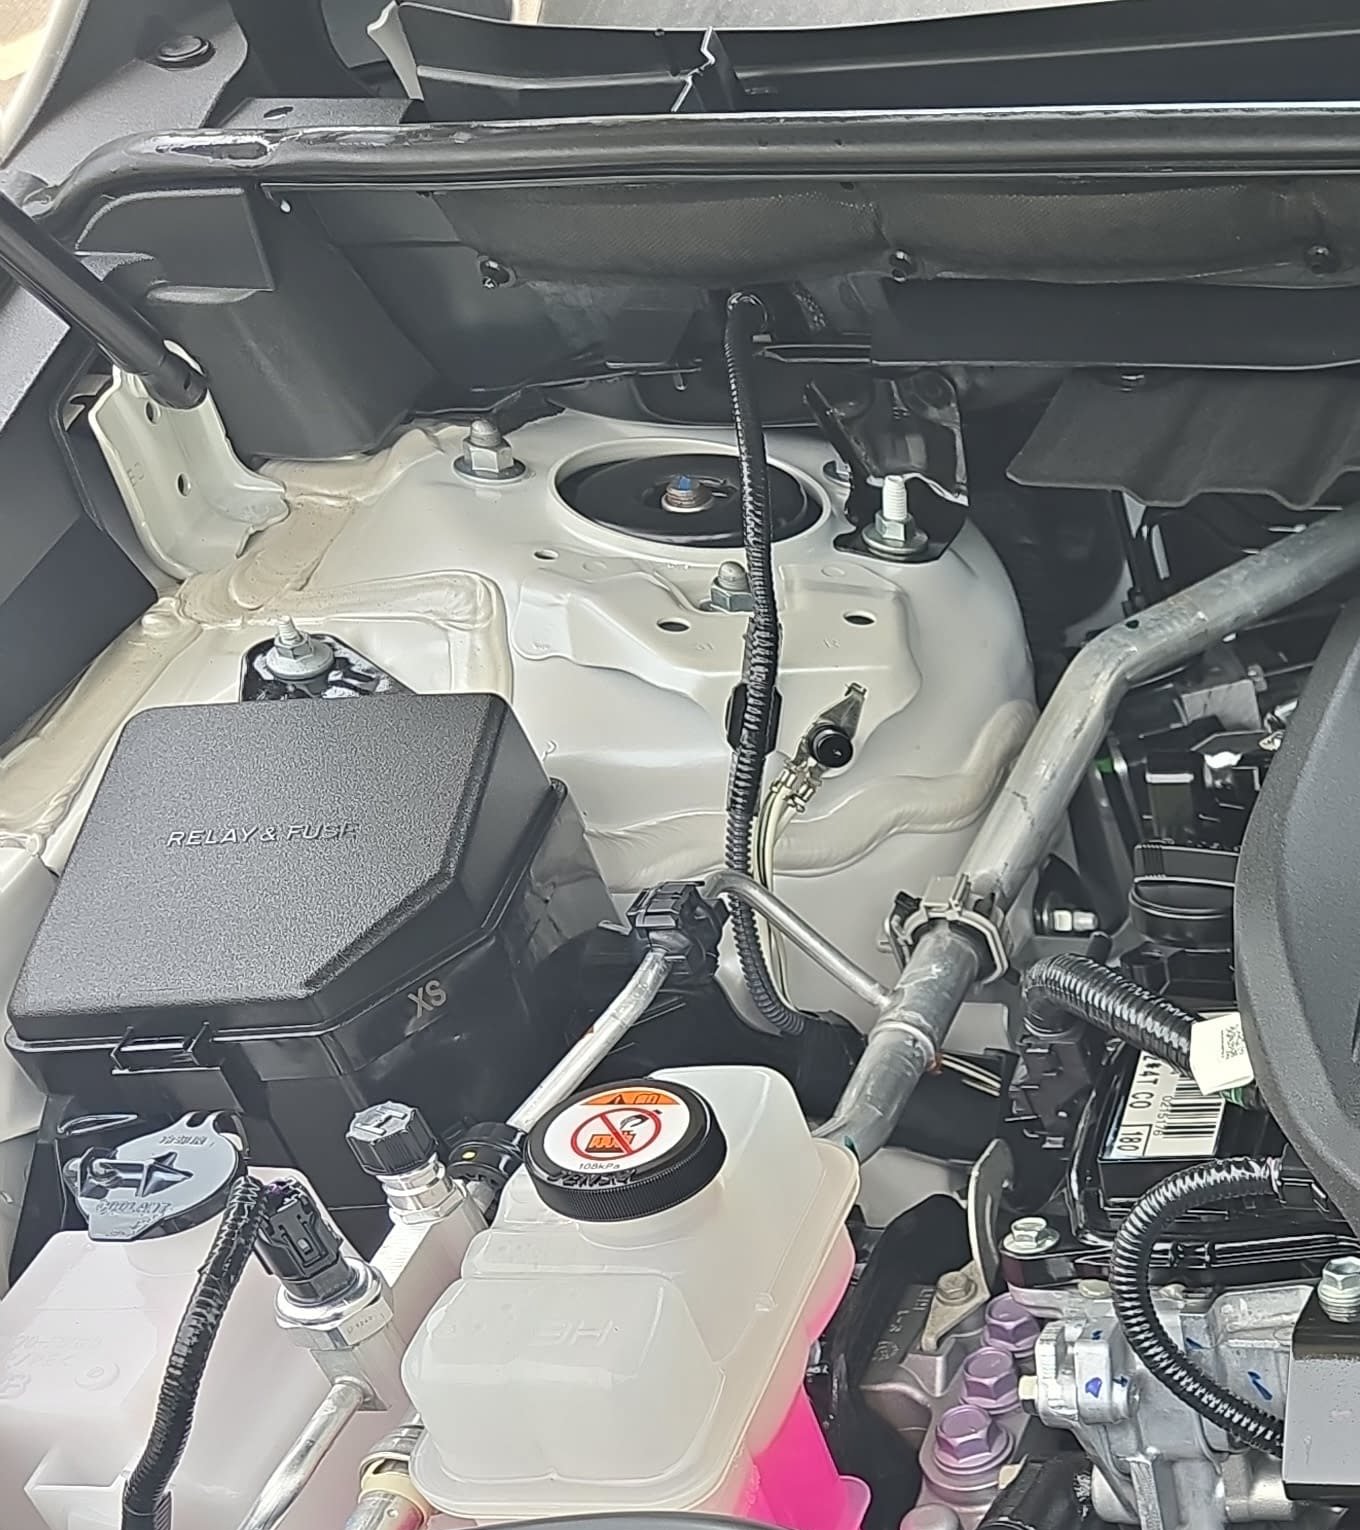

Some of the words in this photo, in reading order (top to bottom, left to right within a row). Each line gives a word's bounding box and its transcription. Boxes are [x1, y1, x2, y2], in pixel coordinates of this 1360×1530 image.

[166, 826, 258, 847] RELAY
[259, 826, 278, 842] &
[407, 979, 448, 1018] XS
[1116, 1131, 1144, 1152] 180
